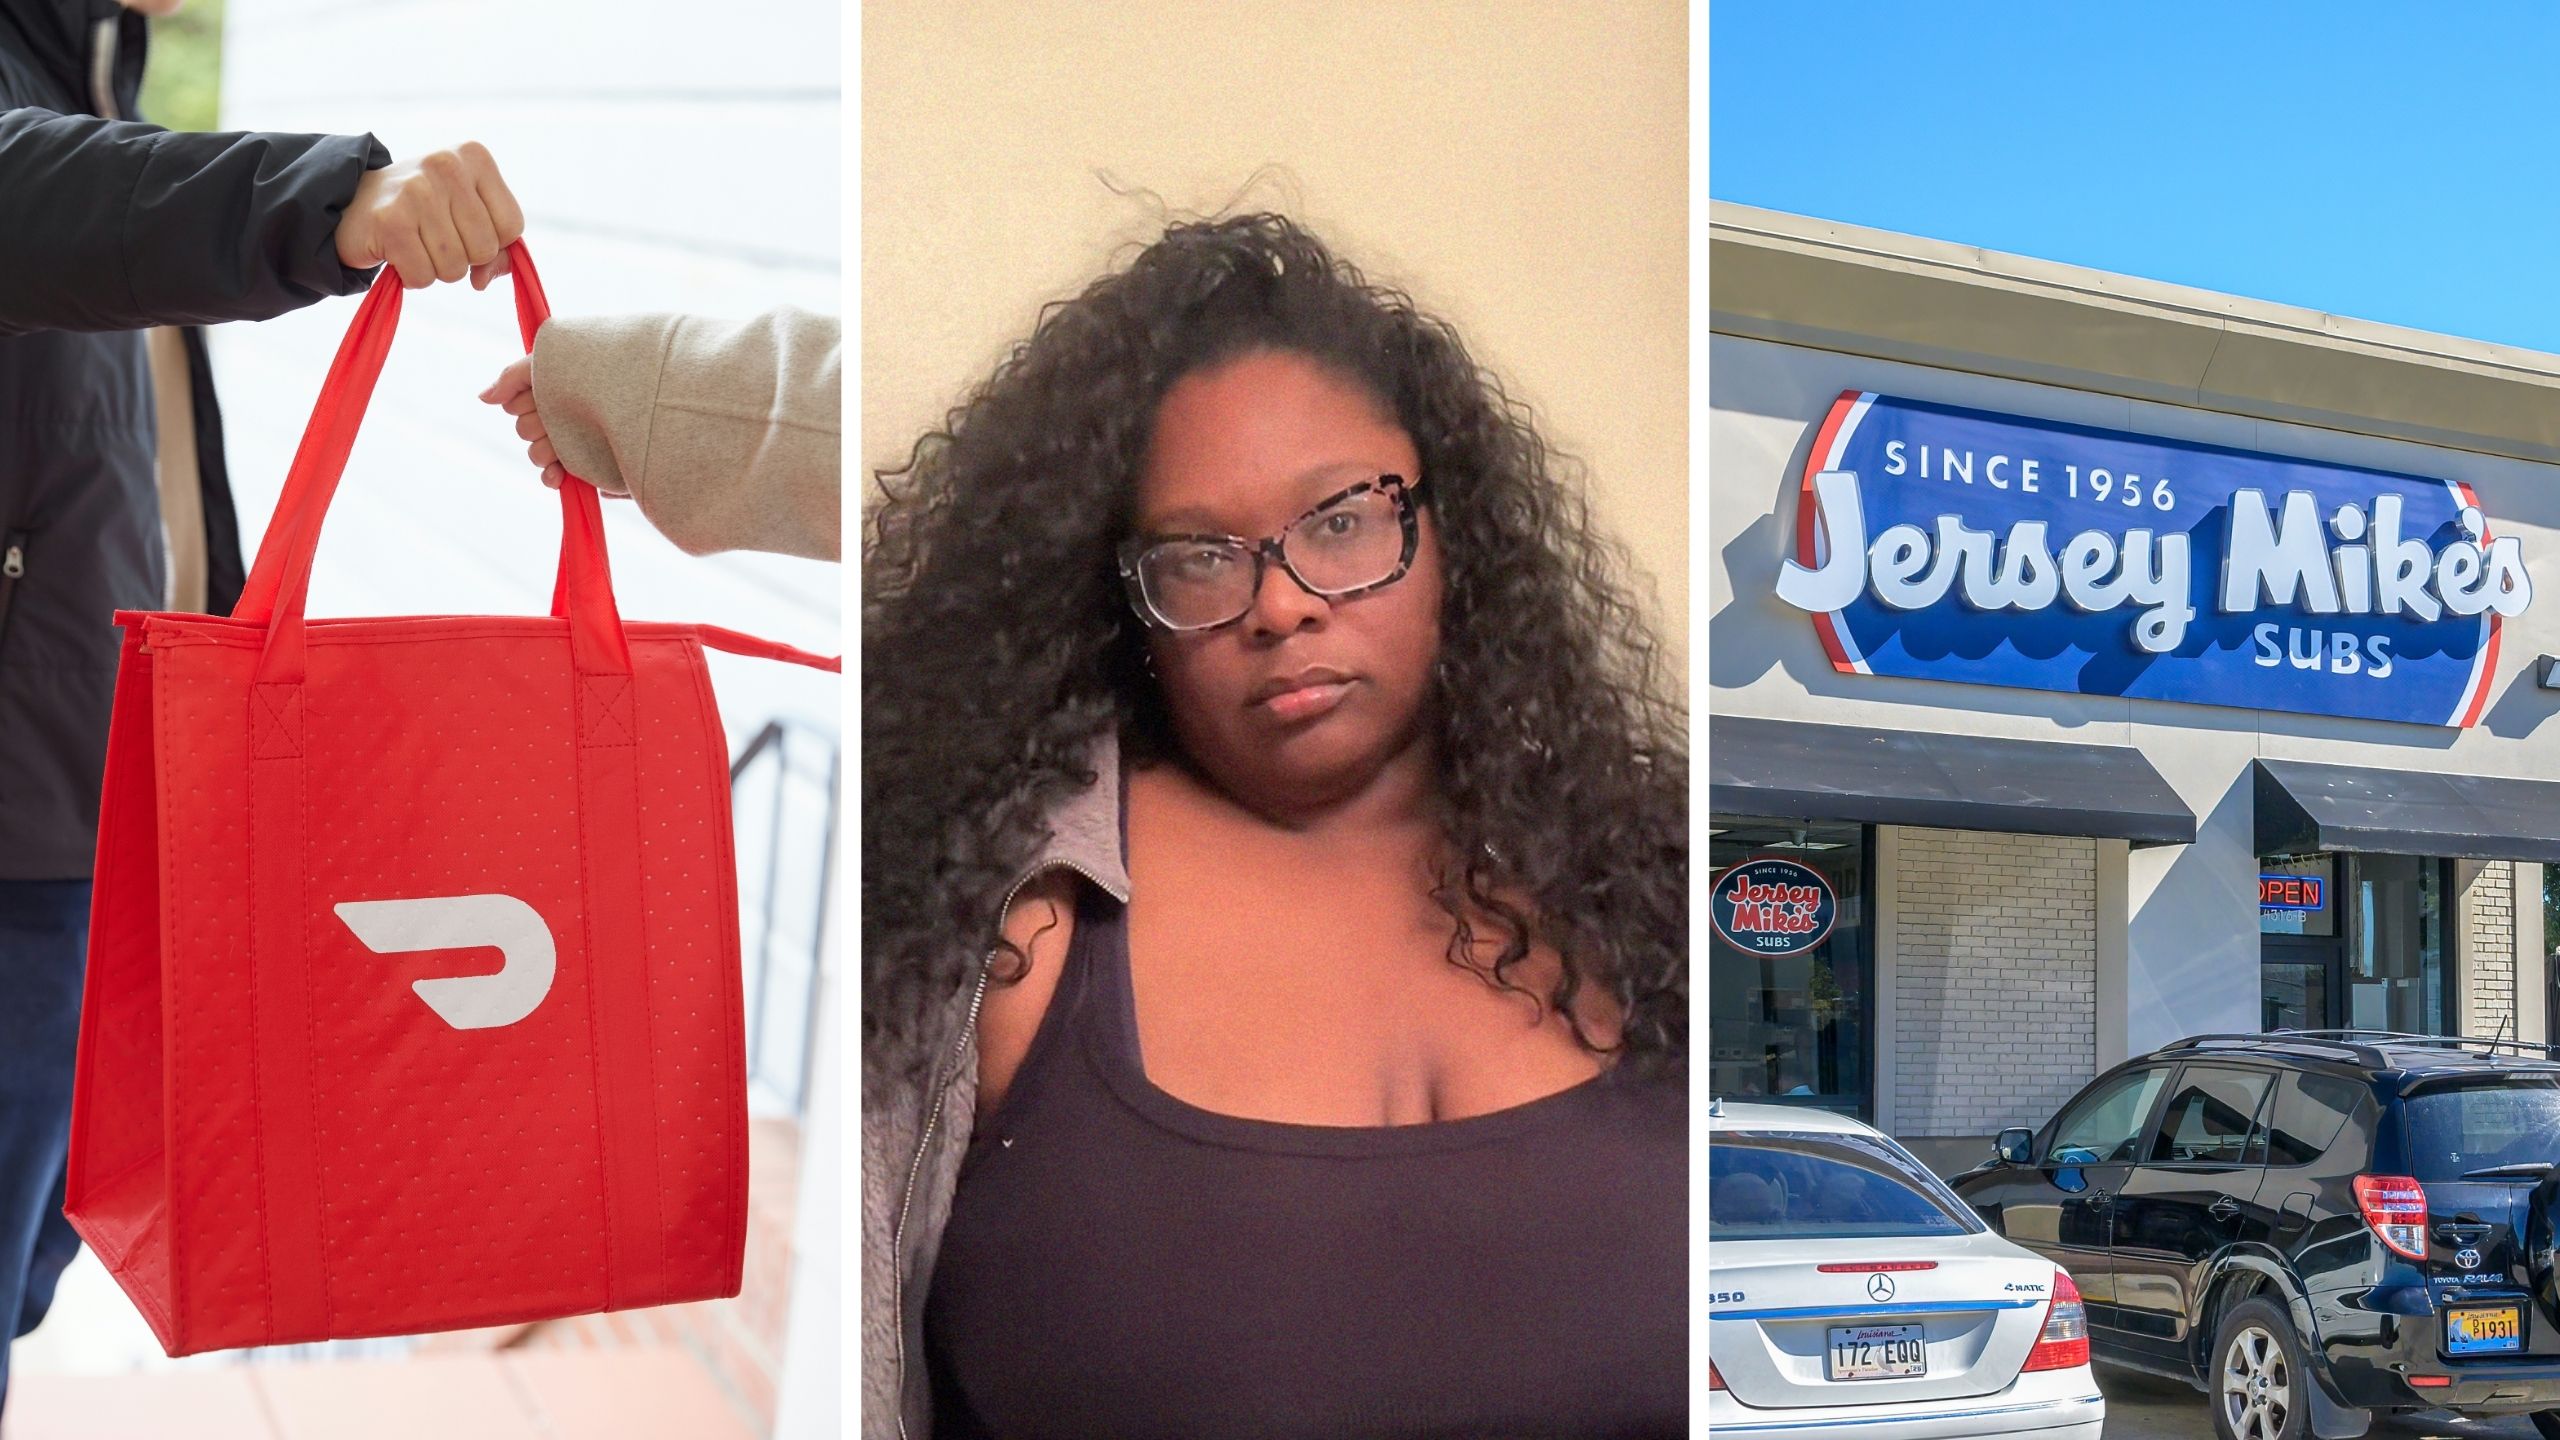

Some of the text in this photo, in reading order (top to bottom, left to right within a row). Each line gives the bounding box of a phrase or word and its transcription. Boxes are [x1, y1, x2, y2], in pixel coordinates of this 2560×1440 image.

[1884, 441, 2177, 512] SINCE 1956
[1775, 469, 2534, 653] Jersey Mike's
[2254, 622, 2393, 679] SUBS
[1754, 867, 1776, 875] SINCE
[1726, 874, 1821, 913] Jersey
[1731, 902, 1819, 934] Mike's
[1756, 936, 1791, 947] SUBS
[1857, 1328, 1903, 1340] Louisiana
[2481, 1320, 2513, 1340] 1931
[1838, 1339, 1921, 1367] 172 EQQ
